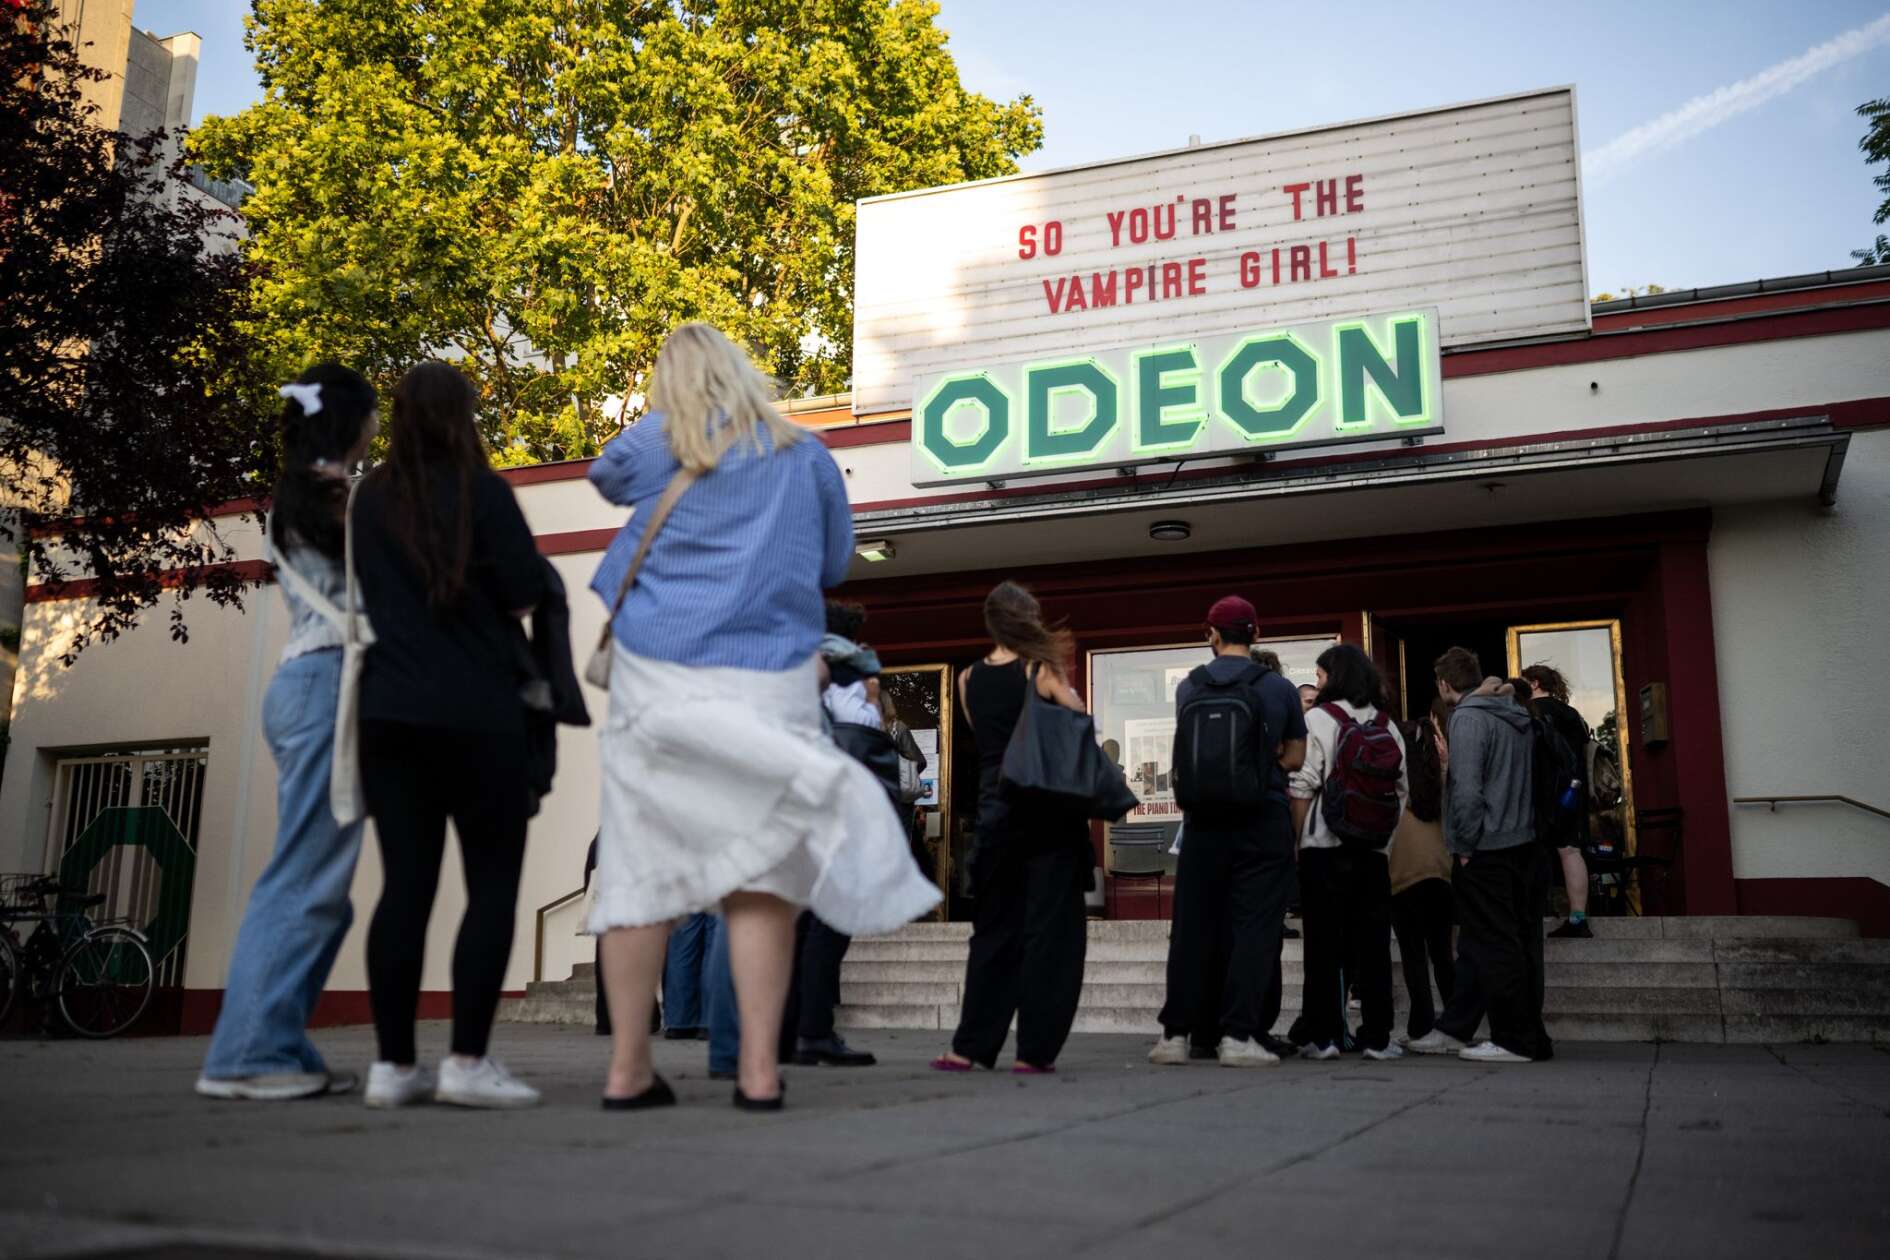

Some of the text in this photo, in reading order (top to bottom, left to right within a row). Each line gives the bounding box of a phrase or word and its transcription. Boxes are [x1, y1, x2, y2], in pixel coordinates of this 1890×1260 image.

[1018, 174, 1364, 261] SO YOU'RE THE
[1042, 237, 1357, 314] VAMPIRE GIRL!
[918, 314, 1426, 474] ODEON
